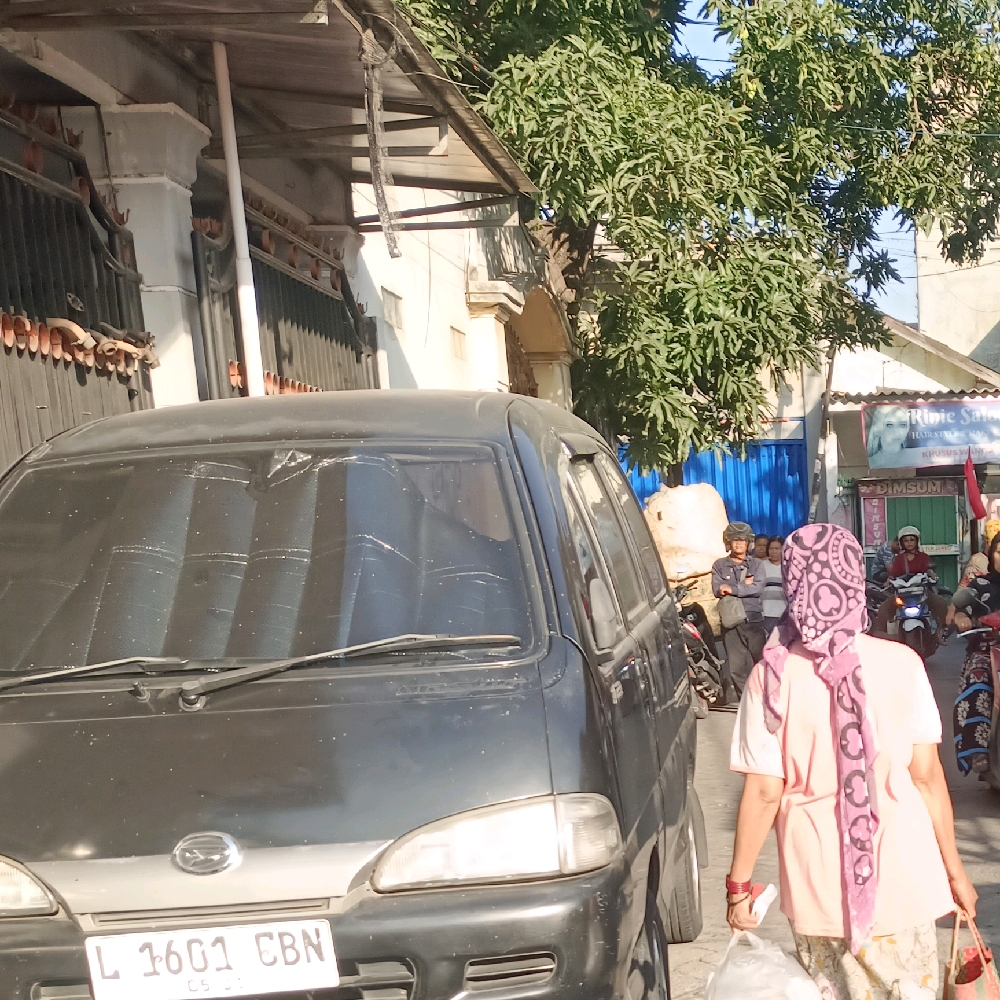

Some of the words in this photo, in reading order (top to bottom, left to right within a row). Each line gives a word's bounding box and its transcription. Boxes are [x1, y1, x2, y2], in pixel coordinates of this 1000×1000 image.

[908, 408, 956, 428] Rinie
[922, 449, 958, 459] KHUSUS
[876, 480, 940, 494] DIMSUM
[95, 945, 121, 980] L
[138, 935, 233, 978] 1601
[254, 927, 326, 967] CBN
